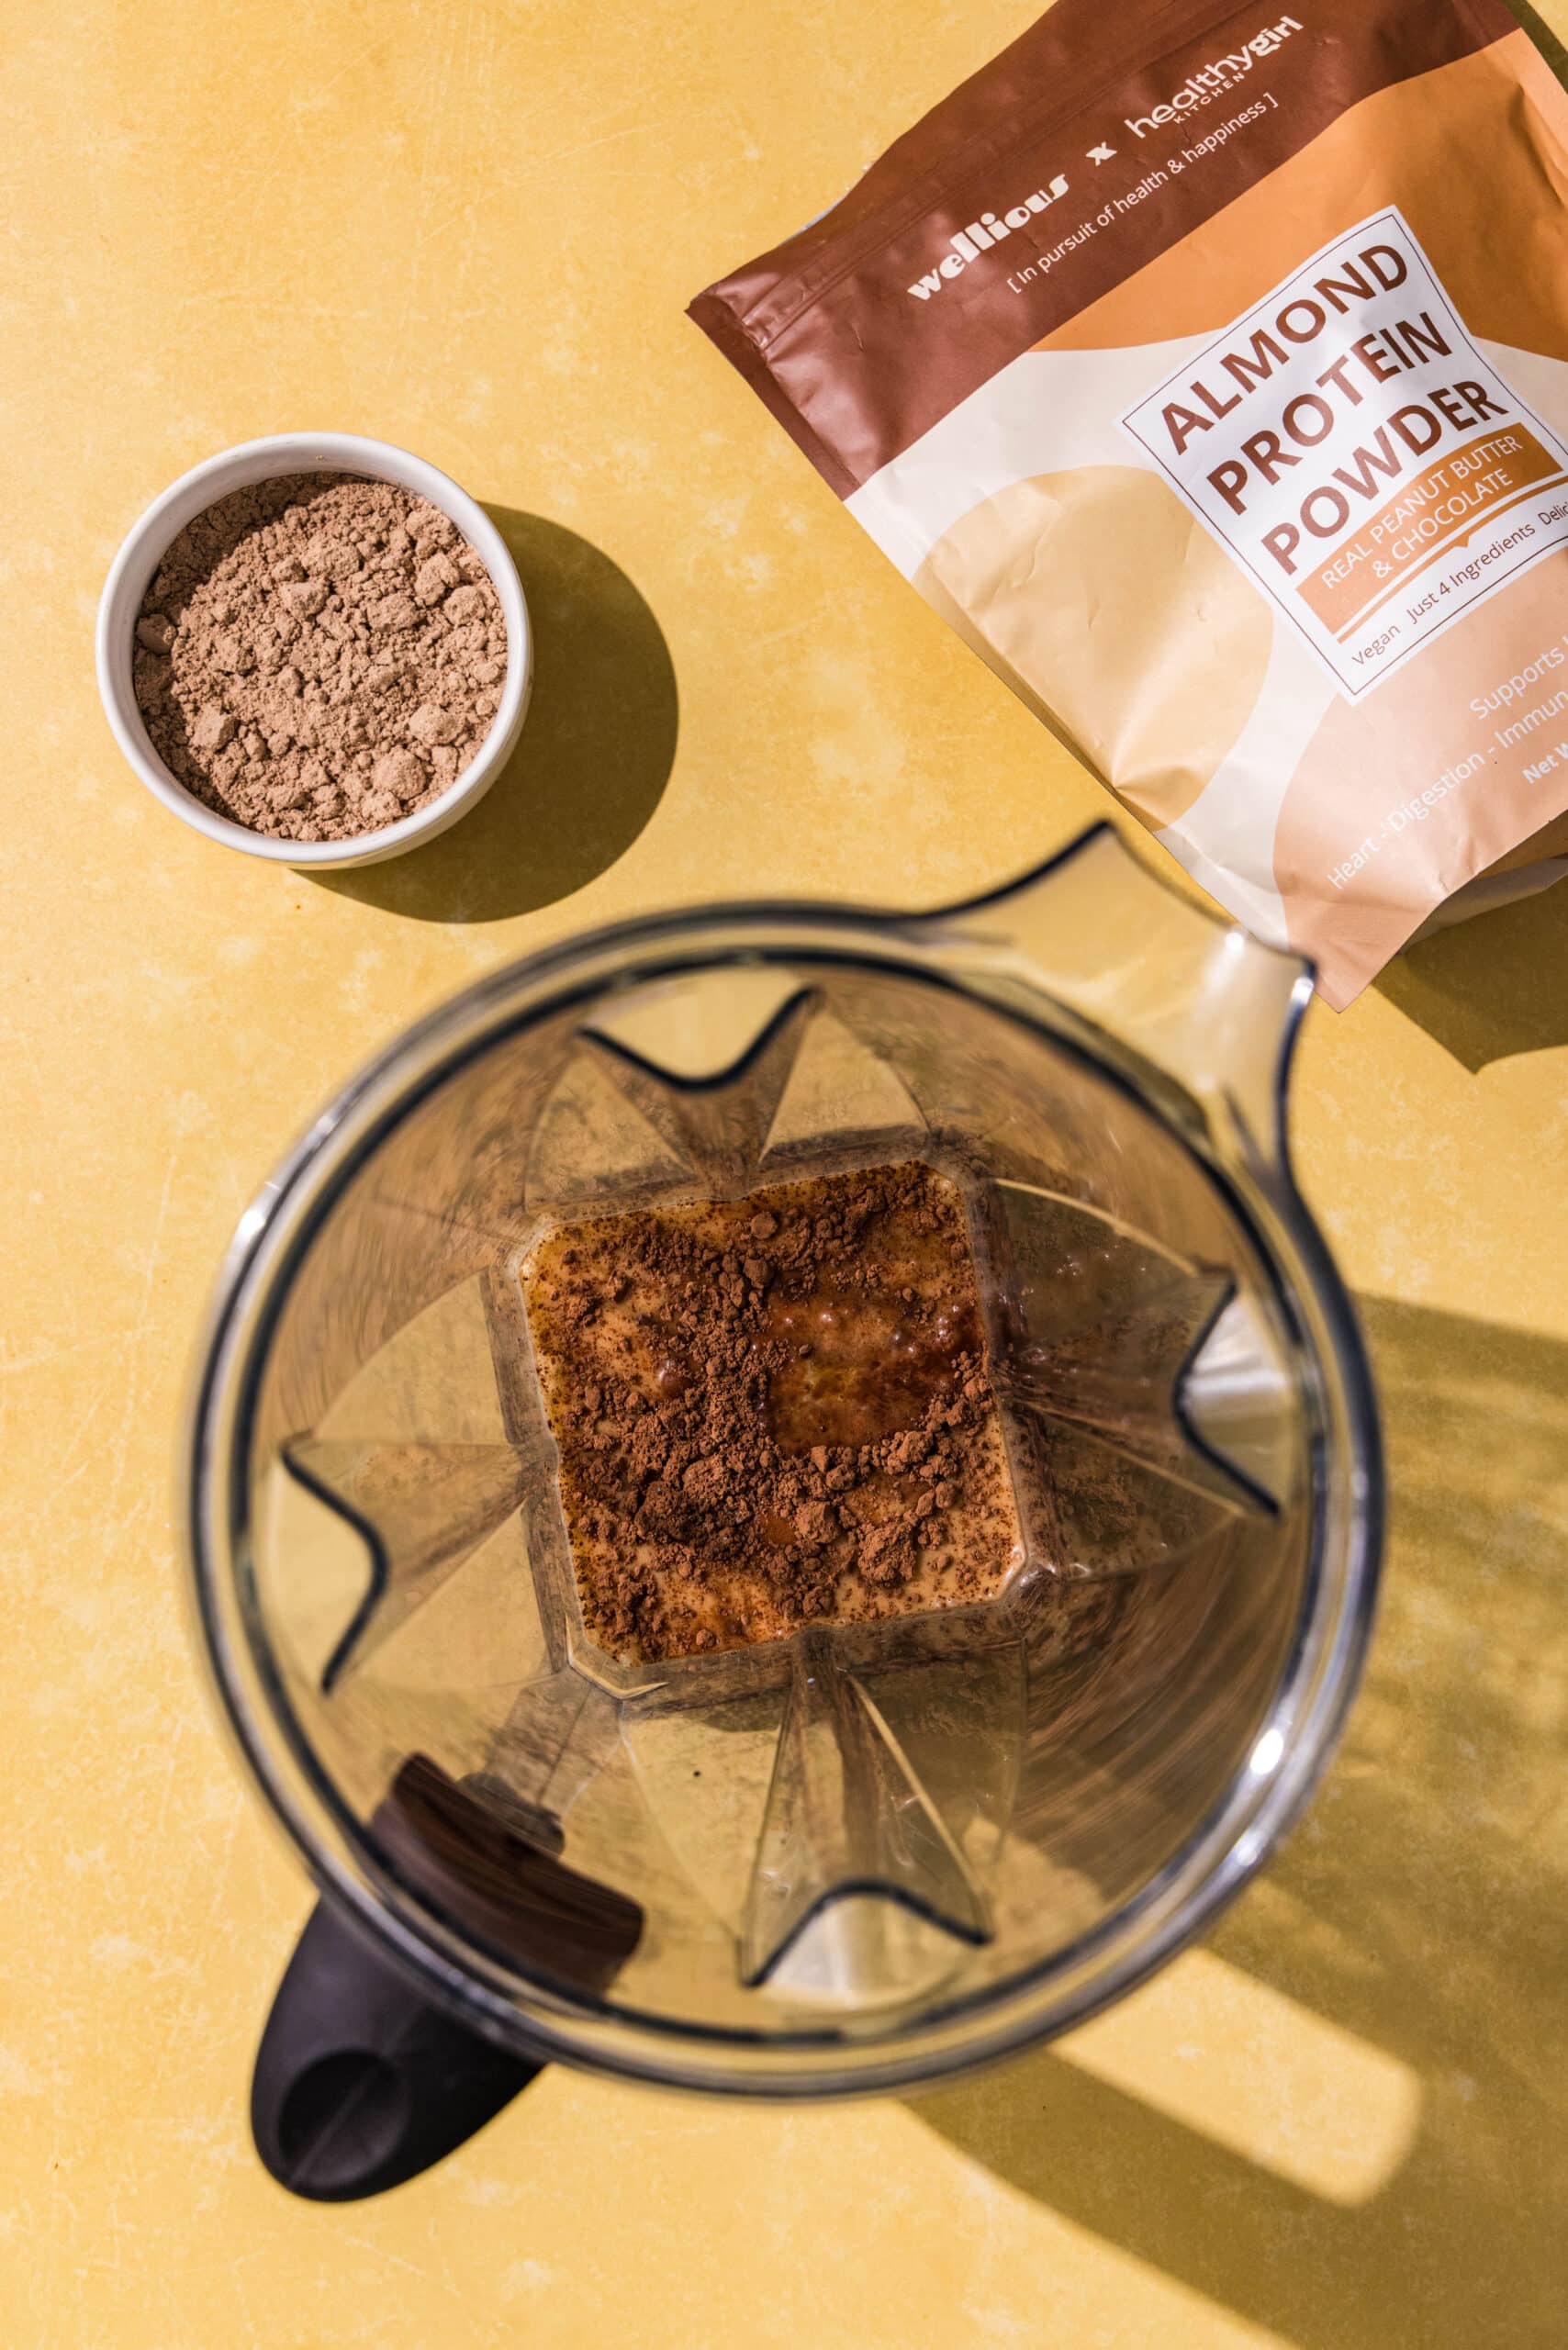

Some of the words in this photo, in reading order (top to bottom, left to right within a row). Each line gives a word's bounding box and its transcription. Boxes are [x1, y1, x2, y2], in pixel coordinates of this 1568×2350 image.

[907, 173, 1070, 300] wellious
[1124, 16, 1304, 139] healthygirl
[1037, 221, 1098, 274] pursuit
[1097, 204, 1116, 227] of
[1114, 169, 1169, 214] health
[1167, 159, 1187, 174] &
[1182, 101, 1267, 163] happiness
[1160, 244, 1408, 456] ALMOND
[1206, 311, 1453, 516] PROTEIN
[1260, 380, 1509, 576] POWDER
[1321, 543, 1373, 589] REAL
[1370, 469, 1451, 544] PEANUT
[1449, 435, 1524, 479] BUTTER
[1372, 559, 1394, 579] &
[1391, 468, 1513, 562] CHOCOLATE
[1351, 622, 1401, 666] Vegan
[1406, 593, 1439, 625] Just
[1439, 581, 1451, 597] 4
[1449, 523, 1536, 587] Ingredients
[1469, 647, 1565, 720] Supports
[1327, 837, 1381, 889] Heart
[1387, 753, 1485, 832] Digestion
[1522, 755, 1559, 784] Net
